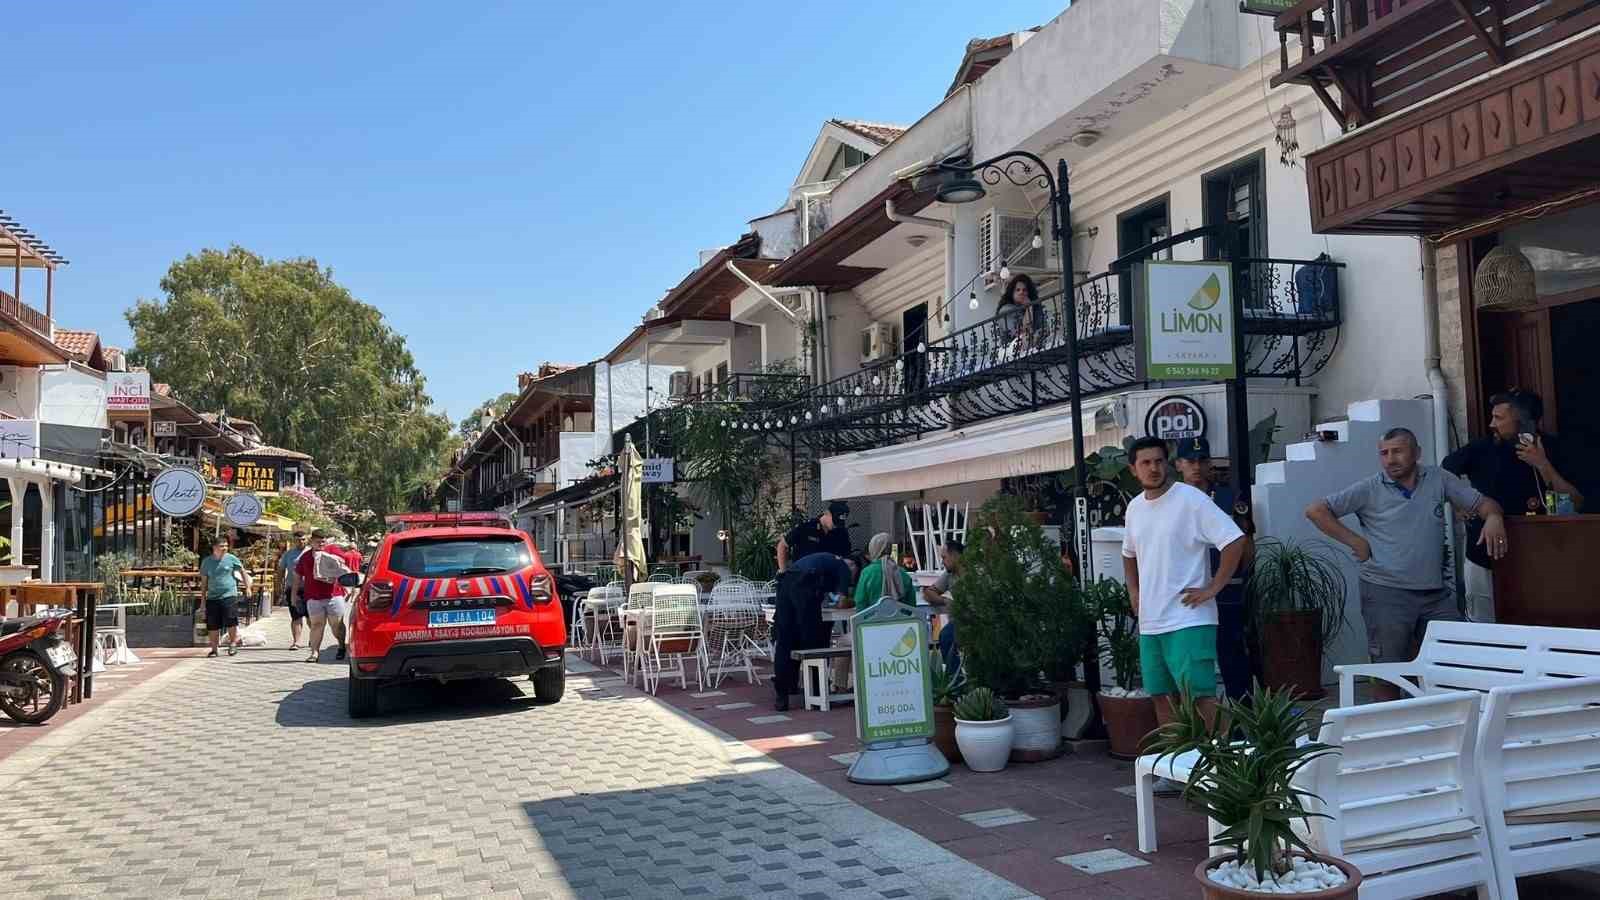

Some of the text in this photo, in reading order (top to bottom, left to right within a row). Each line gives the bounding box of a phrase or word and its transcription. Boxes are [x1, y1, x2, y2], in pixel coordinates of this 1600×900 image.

[1160, 308, 1223, 333] LİMON
[1157, 407, 1193, 439] poi
[237, 467, 274, 479] HATAY
[436, 613, 449, 623] 48
[475, 609, 494, 621] 104
[394, 630, 433, 641] JANDARMA
[868, 657, 920, 677] LİMON
